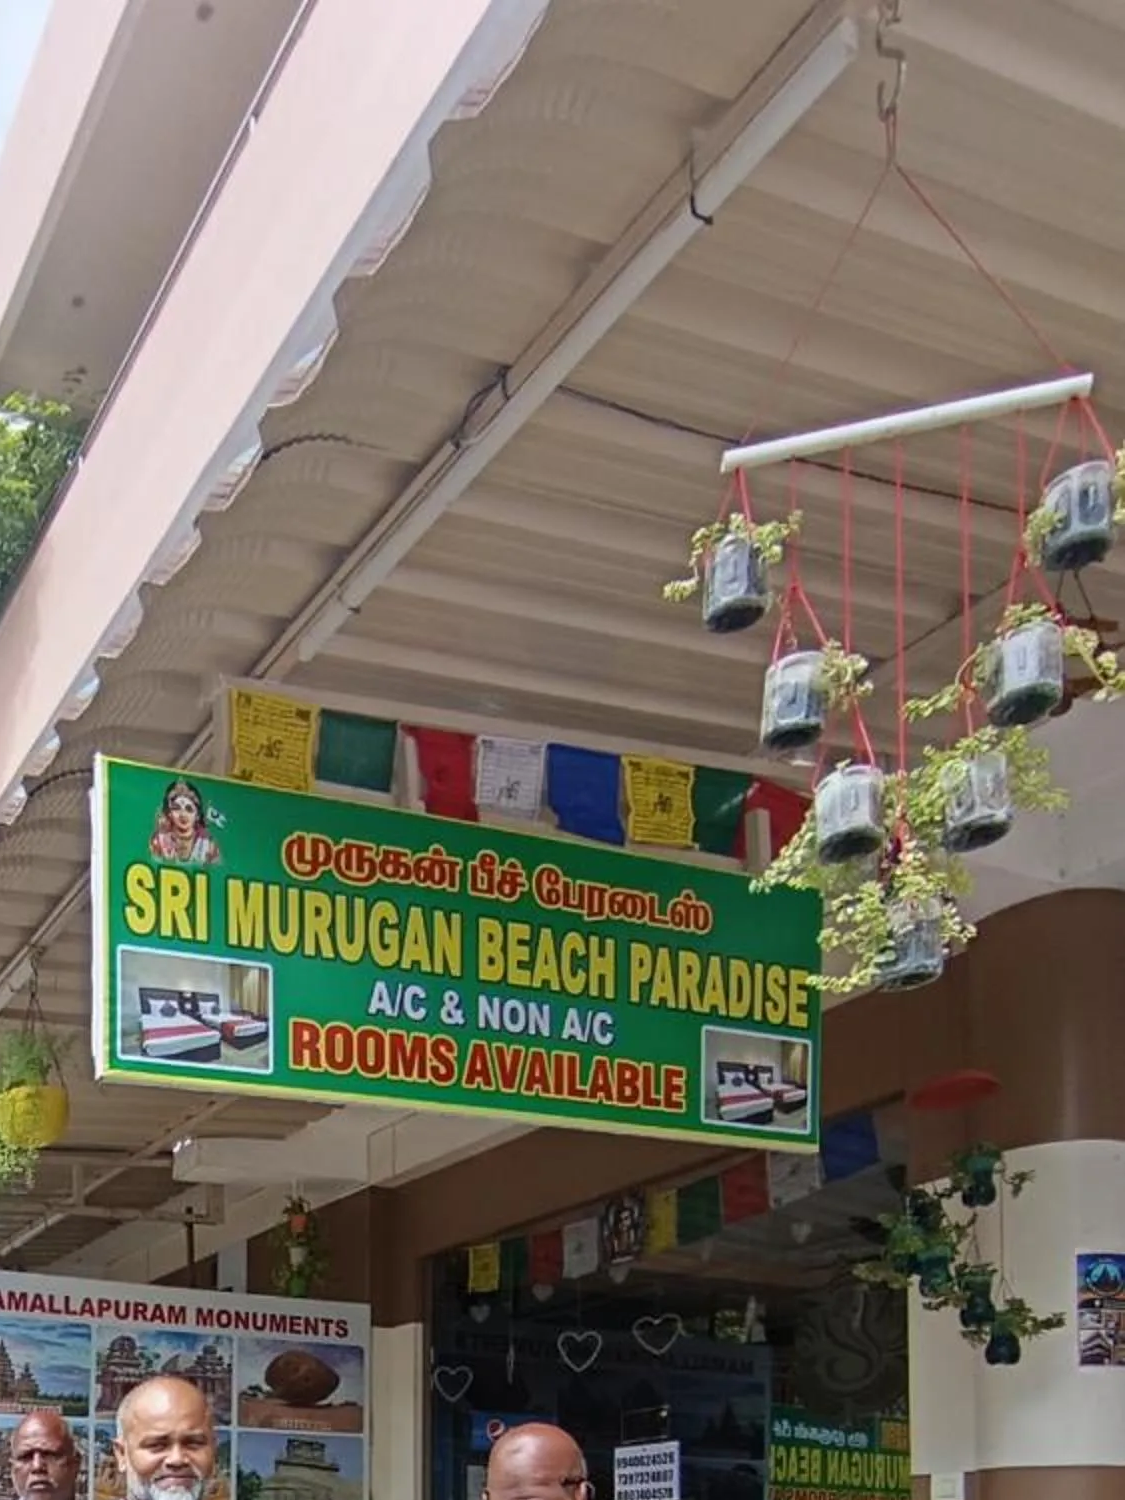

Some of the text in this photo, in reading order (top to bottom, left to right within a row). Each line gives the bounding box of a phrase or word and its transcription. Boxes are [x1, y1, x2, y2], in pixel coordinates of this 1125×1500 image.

[281, 830, 713, 933] முருகன் பீச் பேரடைஸ்
[125, 864, 809, 1027] SRI MURUGAN BEACH PARADISE
[368, 981, 615, 1045] A/C & NON A/C
[289, 1017, 687, 1111] ROOMS AVAILABLE
[196, 1307, 349, 1338] MONUMENTS
